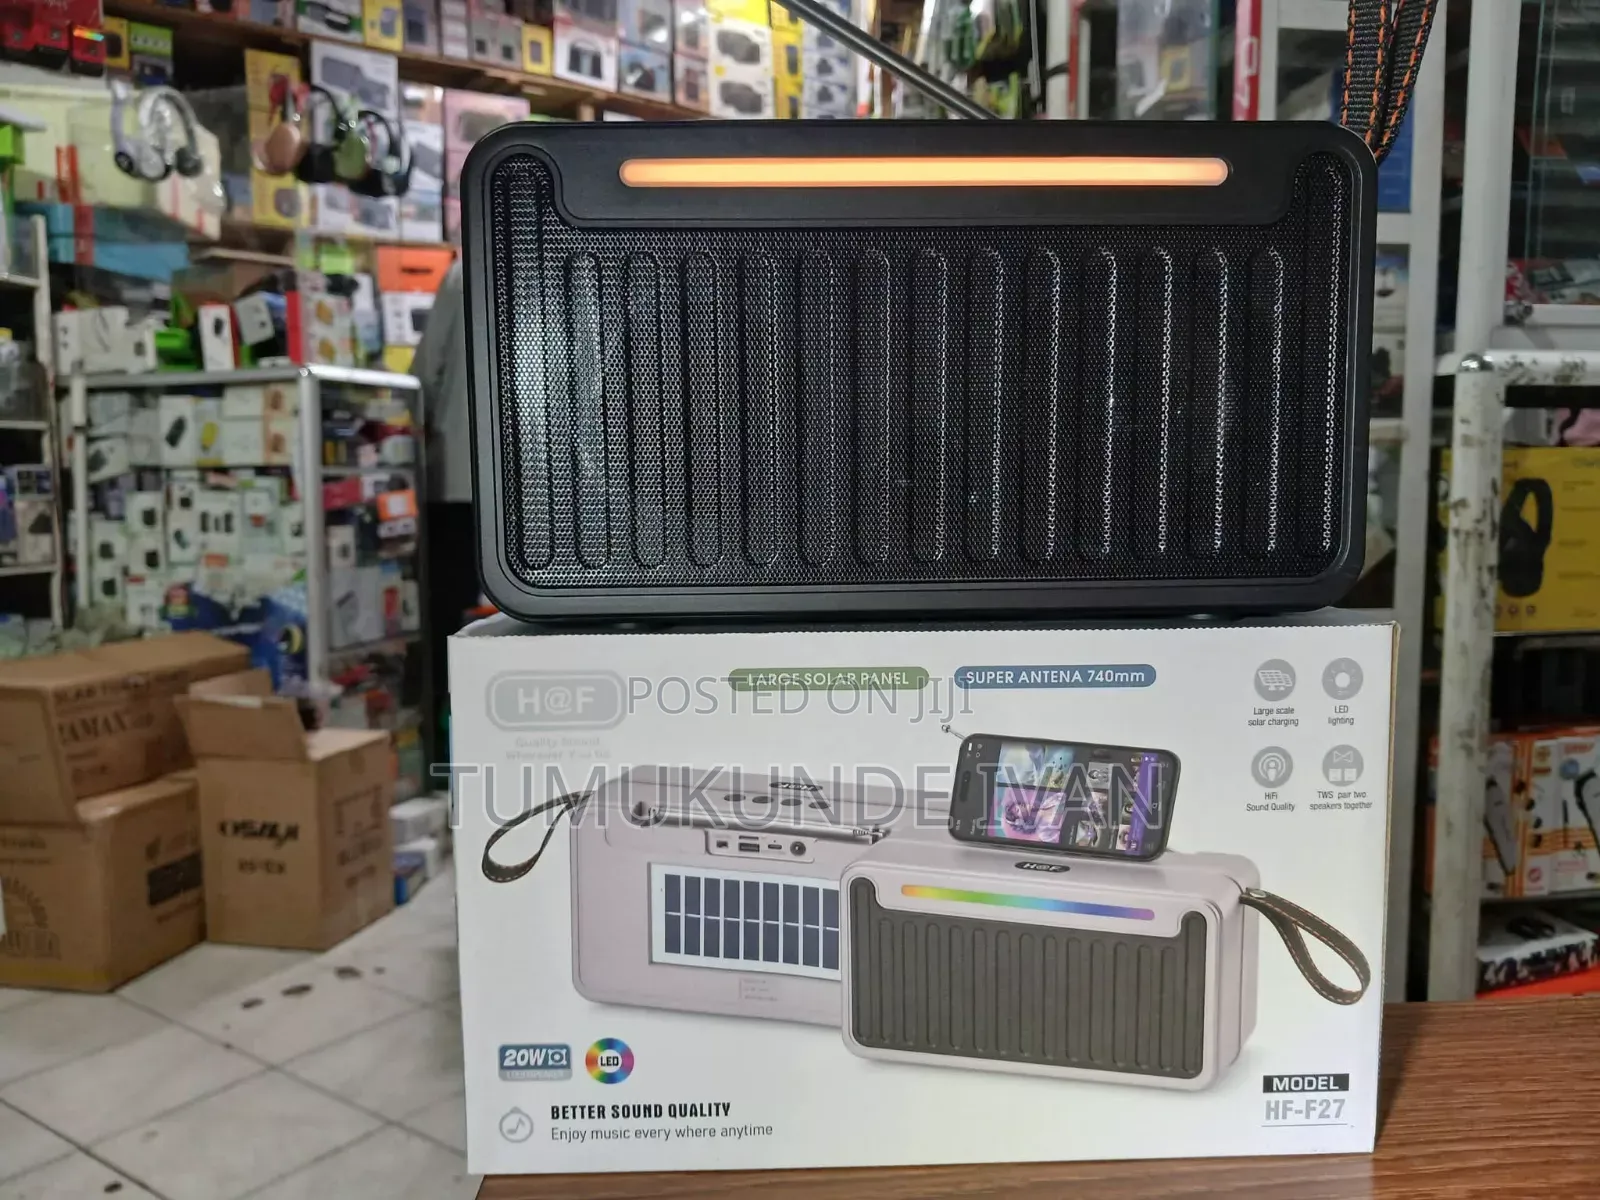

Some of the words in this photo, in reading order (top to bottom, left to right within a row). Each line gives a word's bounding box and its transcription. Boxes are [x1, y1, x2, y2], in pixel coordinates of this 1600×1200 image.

[748, 672, 799, 687] LARGE
[803, 671, 857, 686] SOLAR
[860, 671, 909, 686] PANEL
[965, 670, 1014, 684] SUPER
[1018, 669, 1082, 684] ANTENA
[1087, 669, 1145, 683] 740mm
[517, 686, 596, 715] H@F
[1253, 706, 1274, 716] Large
[1275, 706, 1295, 715] scale
[1334, 705, 1349, 714] LED
[1247, 717, 1266, 727] solar
[1268, 717, 1299, 727] charging
[1327, 716, 1355, 726] lighting
[1264, 791, 1278, 800] HiFi
[1317, 791, 1334, 799] TWS
[1337, 791, 1352, 800] pair
[1353, 791, 1367, 799] two
[1246, 803, 1269, 812] Sound
[1270, 802, 1296, 812] Quality
[1309, 802, 1342, 811] speakers
[1343, 801, 1373, 810] together
[503, 1048, 546, 1067] 20W
[600, 1055, 619, 1067] LED
[1272, 1075, 1340, 1091] MODEL
[551, 1104, 606, 1120] BETTER
[611, 1103, 663, 1119] SOUND
[668, 1102, 731, 1118] QUALITY
[1265, 1098, 1346, 1121] HF-F27
[551, 1127, 587, 1143] Enjoy
[591, 1126, 630, 1139] music
[634, 1127, 671, 1141] every
[675, 1125, 716, 1138] where
[720, 1123, 773, 1140] anytime
